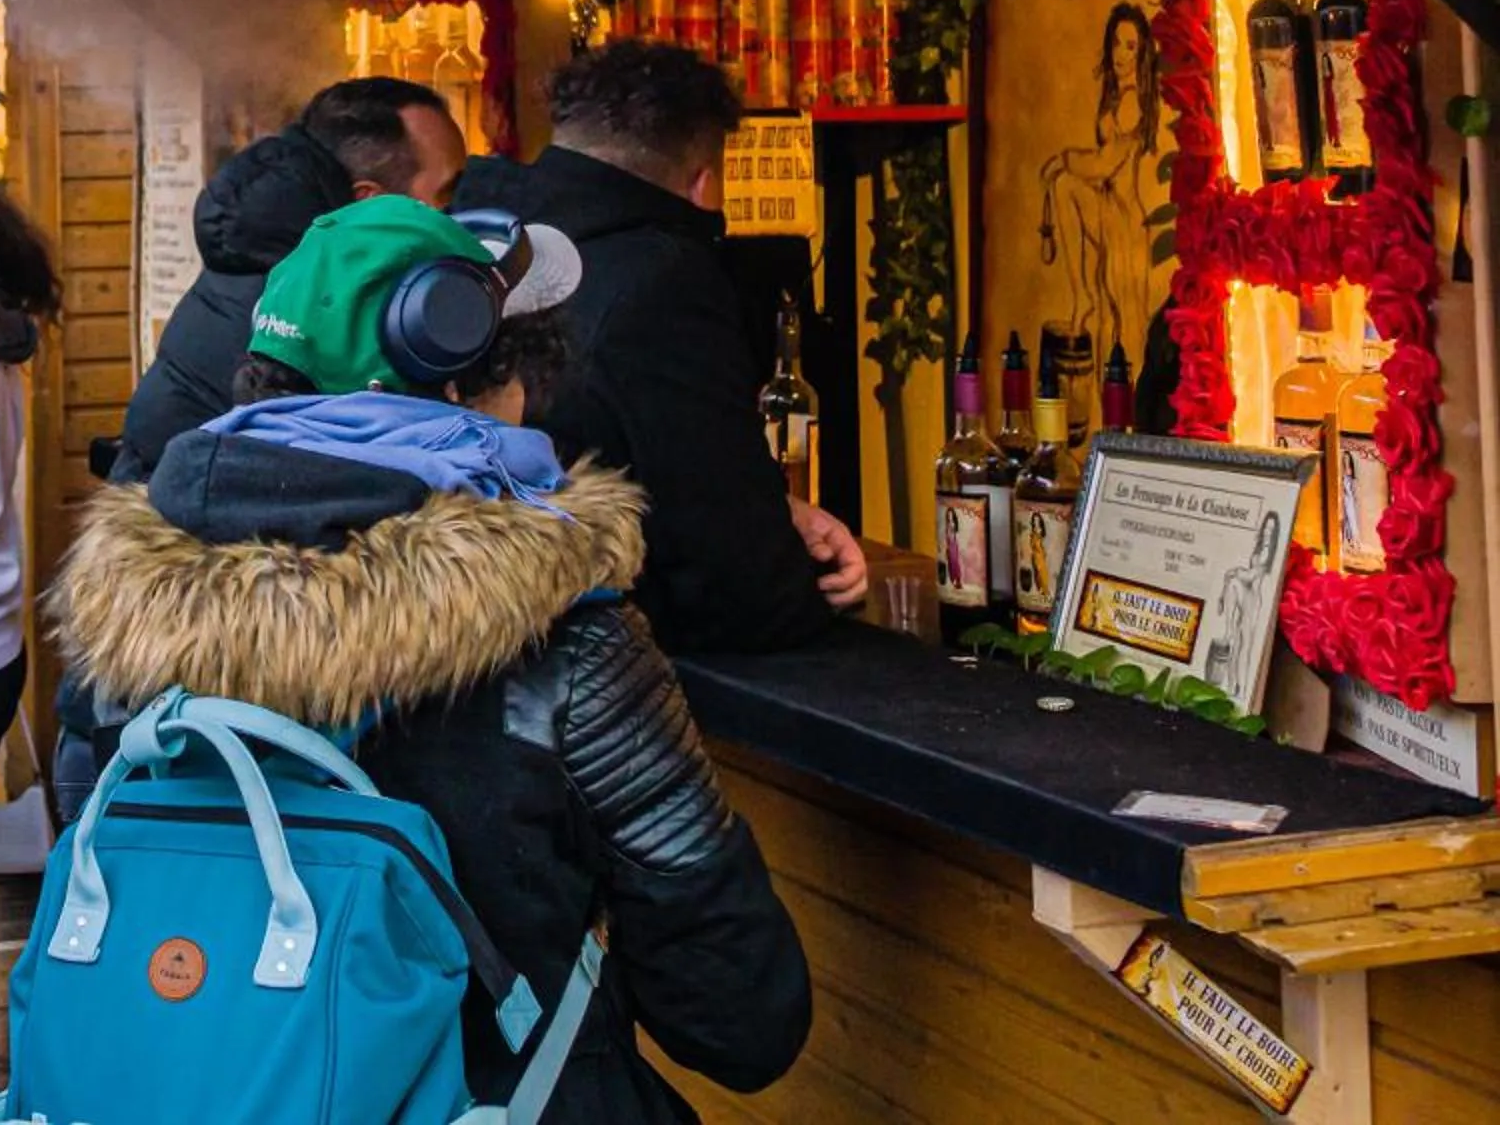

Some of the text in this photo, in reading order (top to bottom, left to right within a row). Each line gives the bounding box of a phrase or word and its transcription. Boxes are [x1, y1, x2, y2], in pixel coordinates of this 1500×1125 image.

[1178, 996, 1217, 1037] POUR
[1215, 1027, 1237, 1051] LE
[1236, 1044, 1286, 1092] CROIRE
[1200, 984, 1238, 1021] FAUT
[1237, 1015, 1260, 1040] LE
[1257, 1032, 1300, 1072] BOIRE
